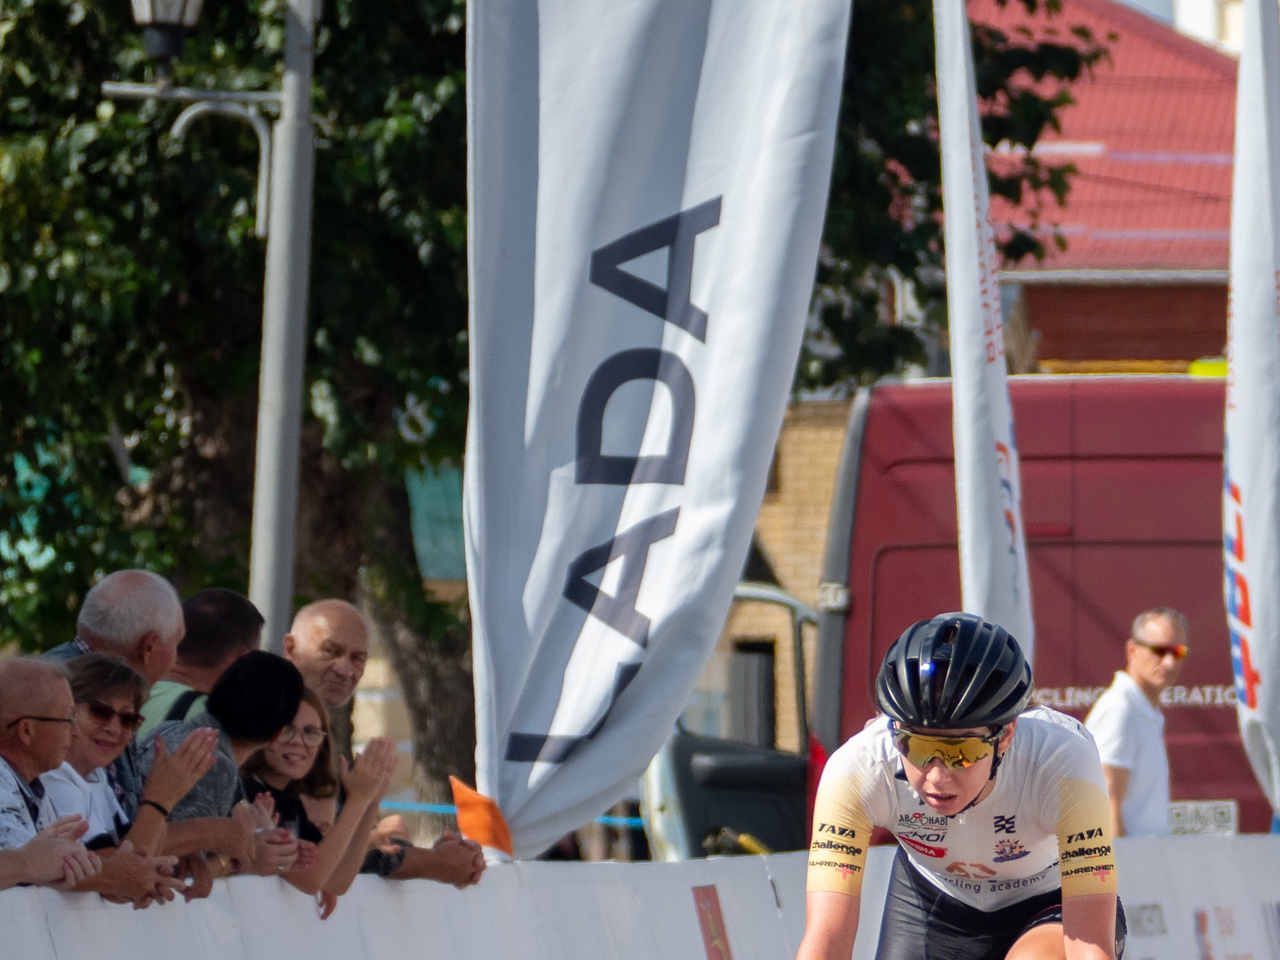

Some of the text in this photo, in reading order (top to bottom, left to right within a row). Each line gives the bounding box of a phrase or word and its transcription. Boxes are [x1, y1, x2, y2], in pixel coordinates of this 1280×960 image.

[504, 195, 722, 763] LADA
[1160, 685, 1237, 705] ERATIO
[818, 823, 856, 839] TAYA
[1066, 827, 1103, 844] TAYA
[812, 840, 862, 856] challenge
[1061, 845, 1111, 860] challenge
[1062, 864, 1114, 877] FAHRENHEIT
